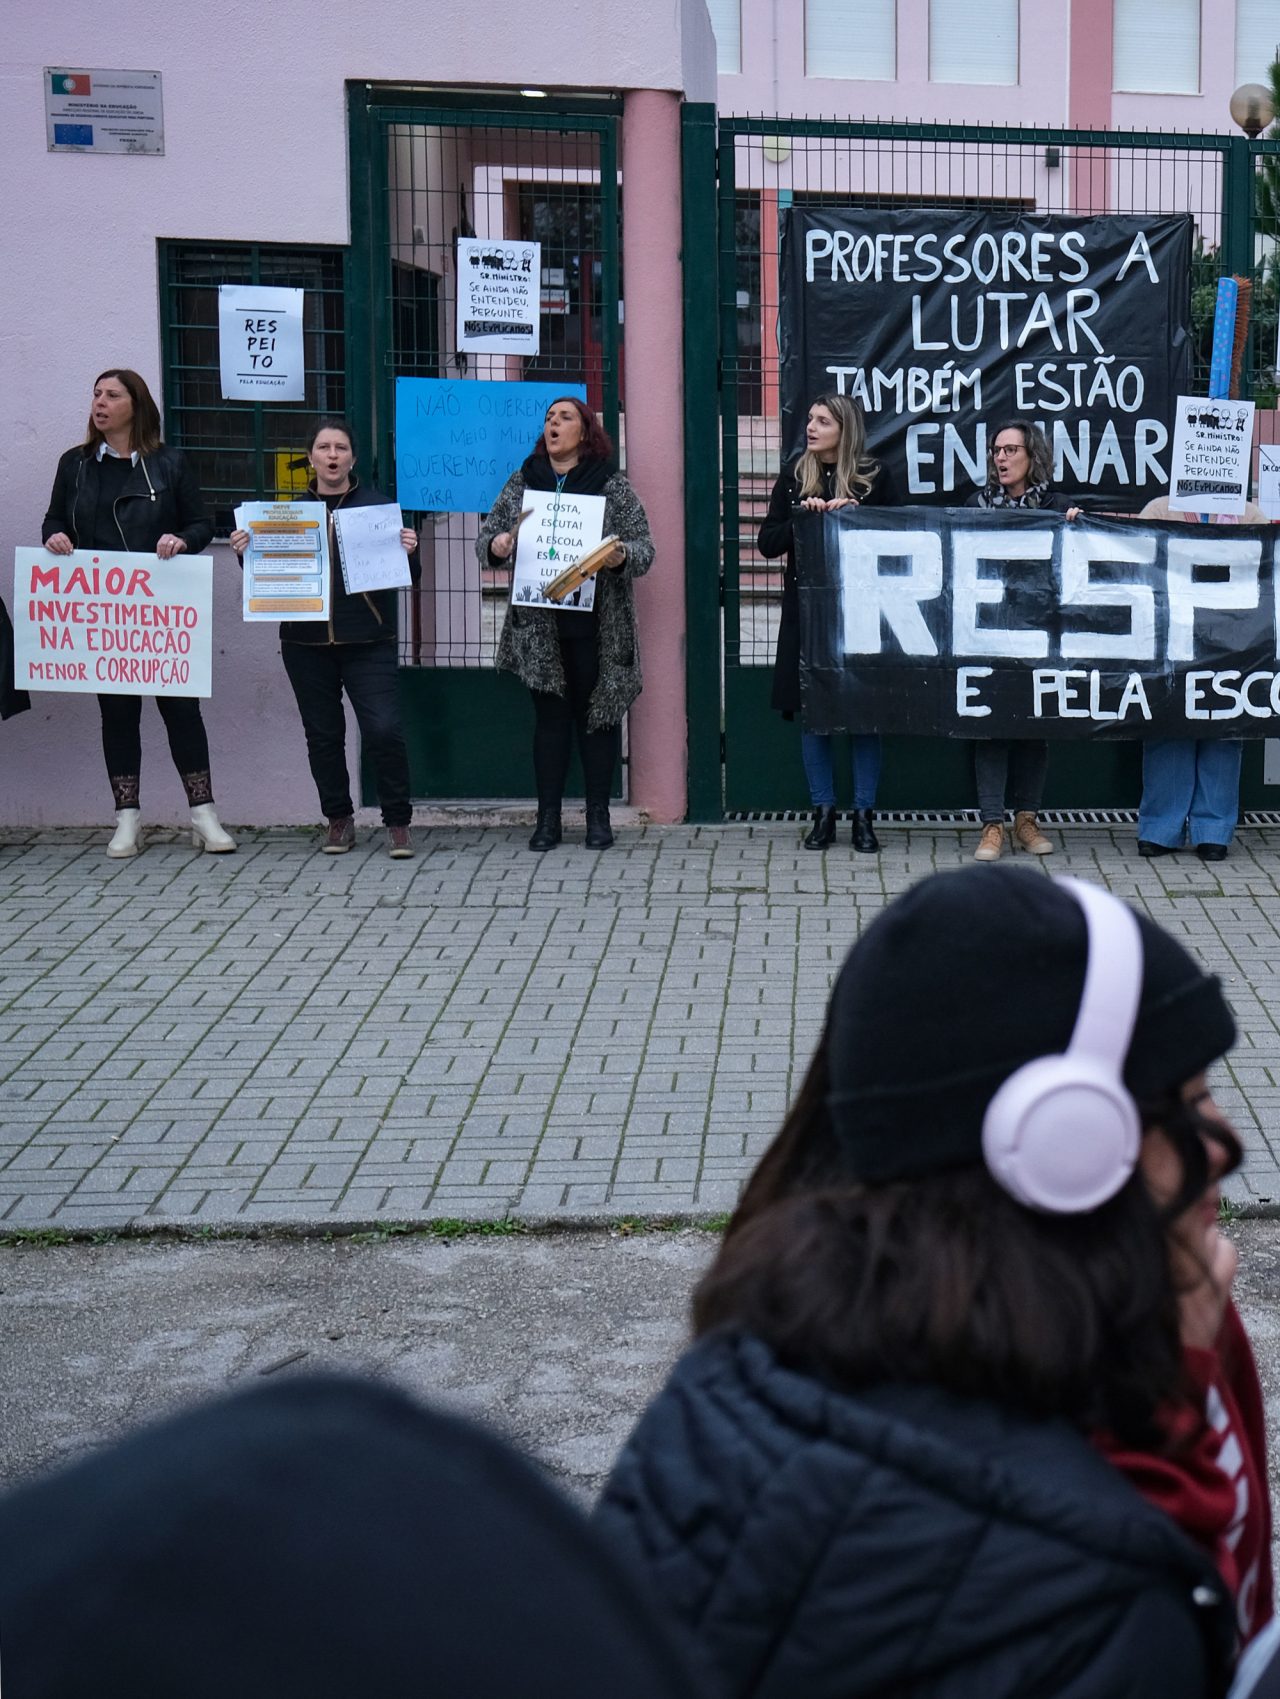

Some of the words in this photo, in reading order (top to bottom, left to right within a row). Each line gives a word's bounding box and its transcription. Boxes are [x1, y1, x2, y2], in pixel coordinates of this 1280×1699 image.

[805, 229, 1089, 285] PROFESSORES
[1115, 231, 1159, 284] A
[470, 282, 480, 292] SE
[483, 285, 509, 294] AINDA
[512, 286, 528, 295] NÃO
[471, 294, 528, 307] ENTENDEU,
[245, 318, 277, 334] RES
[464, 320, 481, 332] NÓS
[911, 288, 1104, 354] LUTAR
[248, 336, 276, 351] PEI
[250, 354, 272, 370] TO
[826, 360, 982, 413] TAMBÉM
[1015, 354, 1144, 412] ESTÃO
[416, 385, 461, 417] NÃO
[450, 427, 487, 447] MEIO
[1185, 440, 1194, 450] SE
[1198, 444, 1221, 452] AINDA
[1224, 444, 1240, 454] NÃO
[401, 453, 497, 479] QUEREMOS
[905, 419, 1168, 495] ENNAR
[1178, 480, 1192, 492] NÓS
[420, 487, 454, 507] PARA
[477, 490, 490, 507] A
[546, 503, 580, 514] COSTA,
[541, 518, 582, 530] ESCUTA!
[536, 535, 543, 544] A
[546, 536, 582, 547] ESCOLA
[564, 554, 578, 562] EM
[30, 557, 154, 597] MAIOR
[540, 568, 563, 578] LUT
[29, 600, 198, 628] INVESTIMENTO
[40, 626, 74, 650] NA
[86, 627, 190, 656] EDUCAÇÃO
[29, 662, 88, 680] MENOR
[96, 656, 190, 688] CORRUPÇÃO
[957, 667, 993, 717] E
[1032, 669, 1152, 720] PELA
